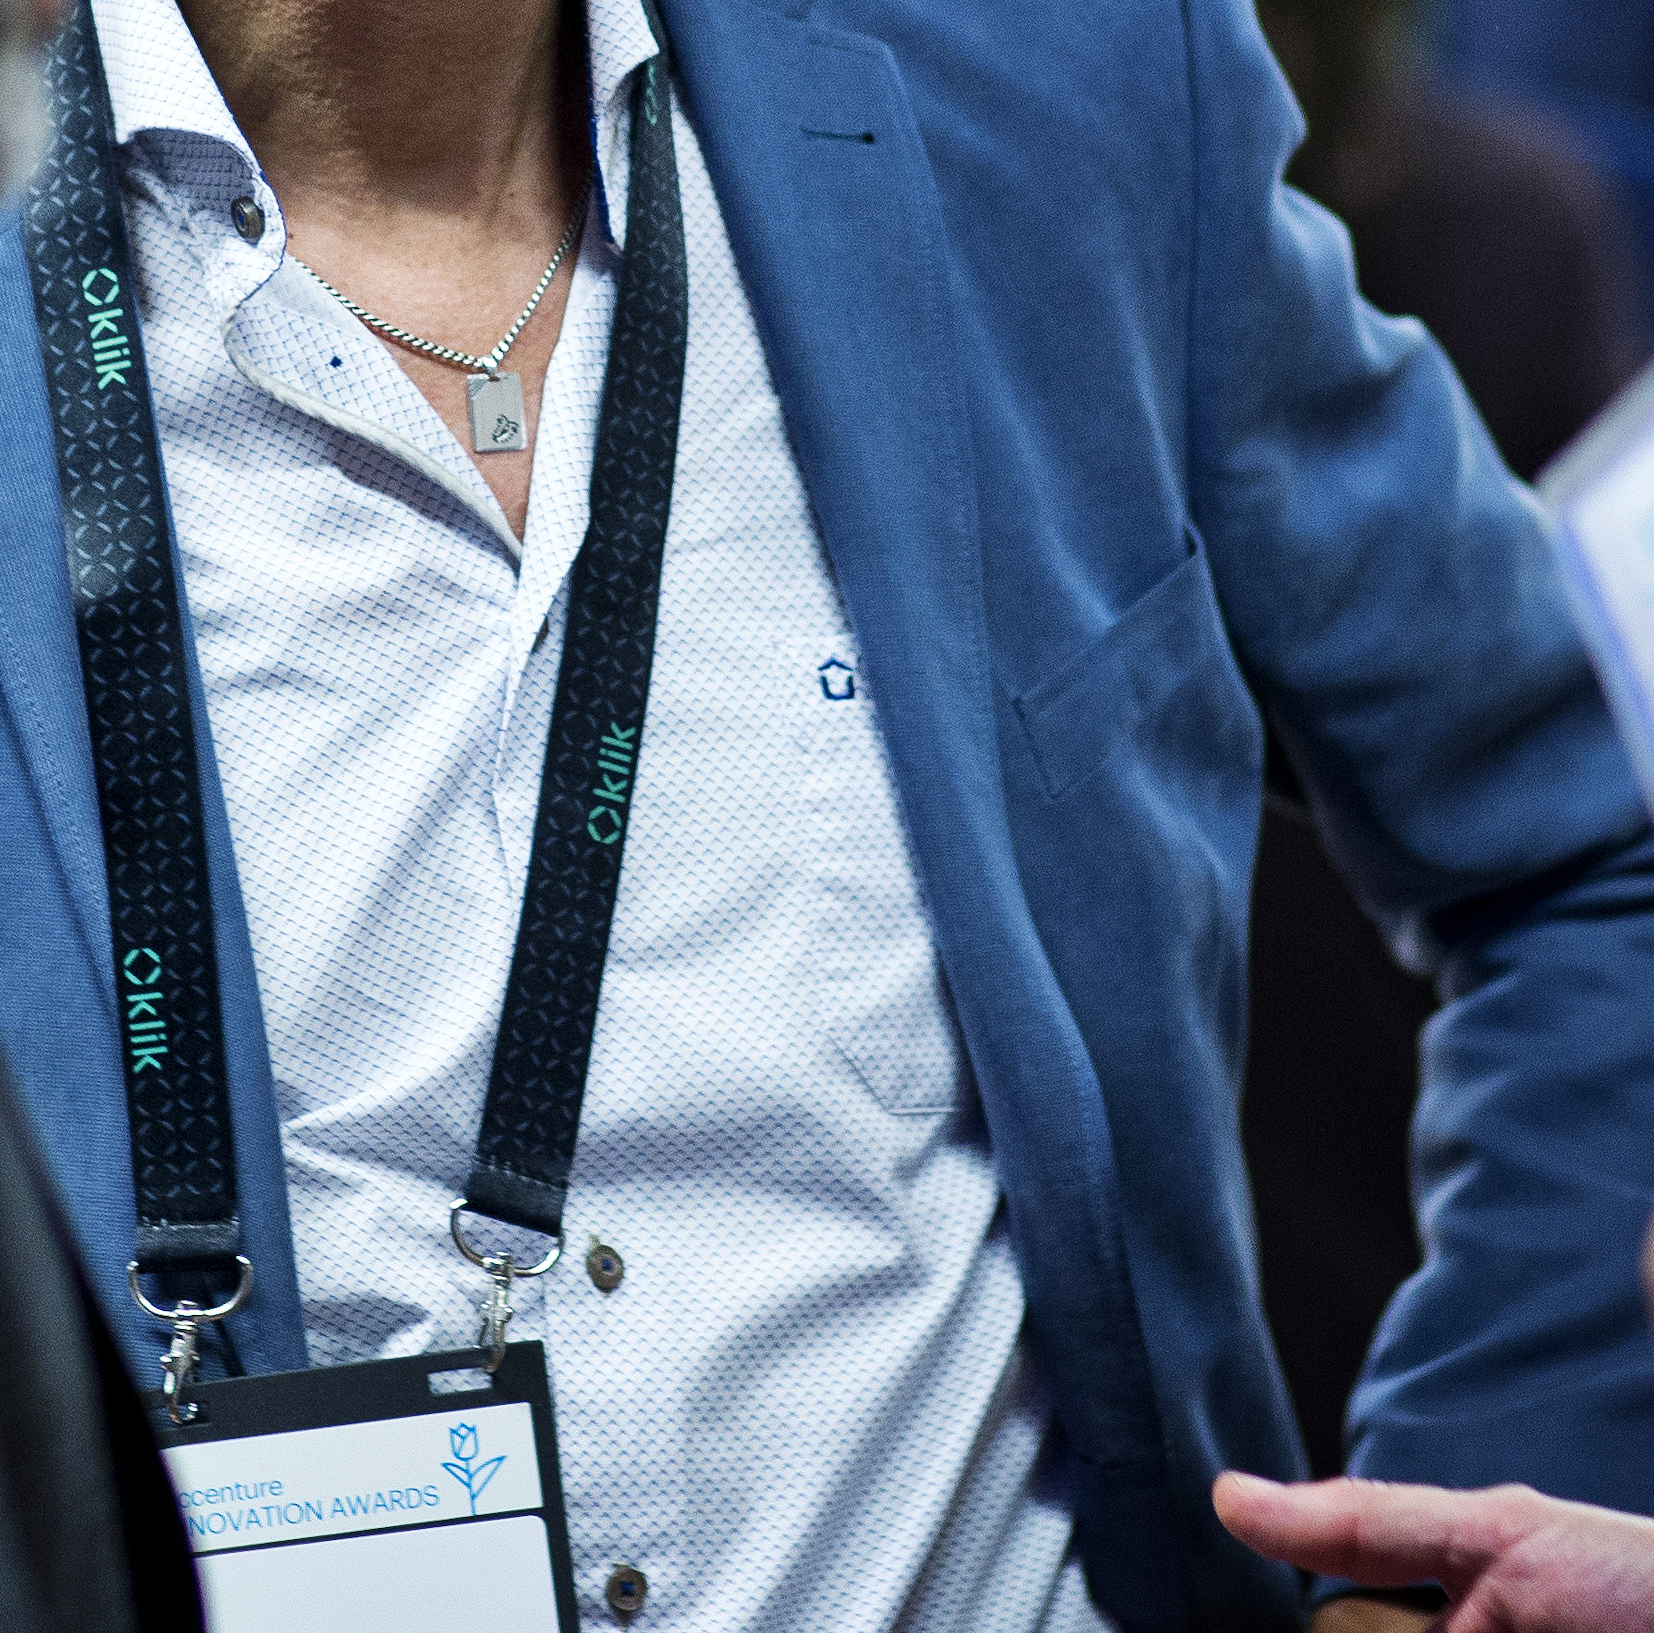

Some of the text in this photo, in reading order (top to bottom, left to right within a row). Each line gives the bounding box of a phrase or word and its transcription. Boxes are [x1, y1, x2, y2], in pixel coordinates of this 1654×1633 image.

[178, 1480, 284, 1510] ccenture
[187, 1484, 440, 1538] NOVATION AWARDS
